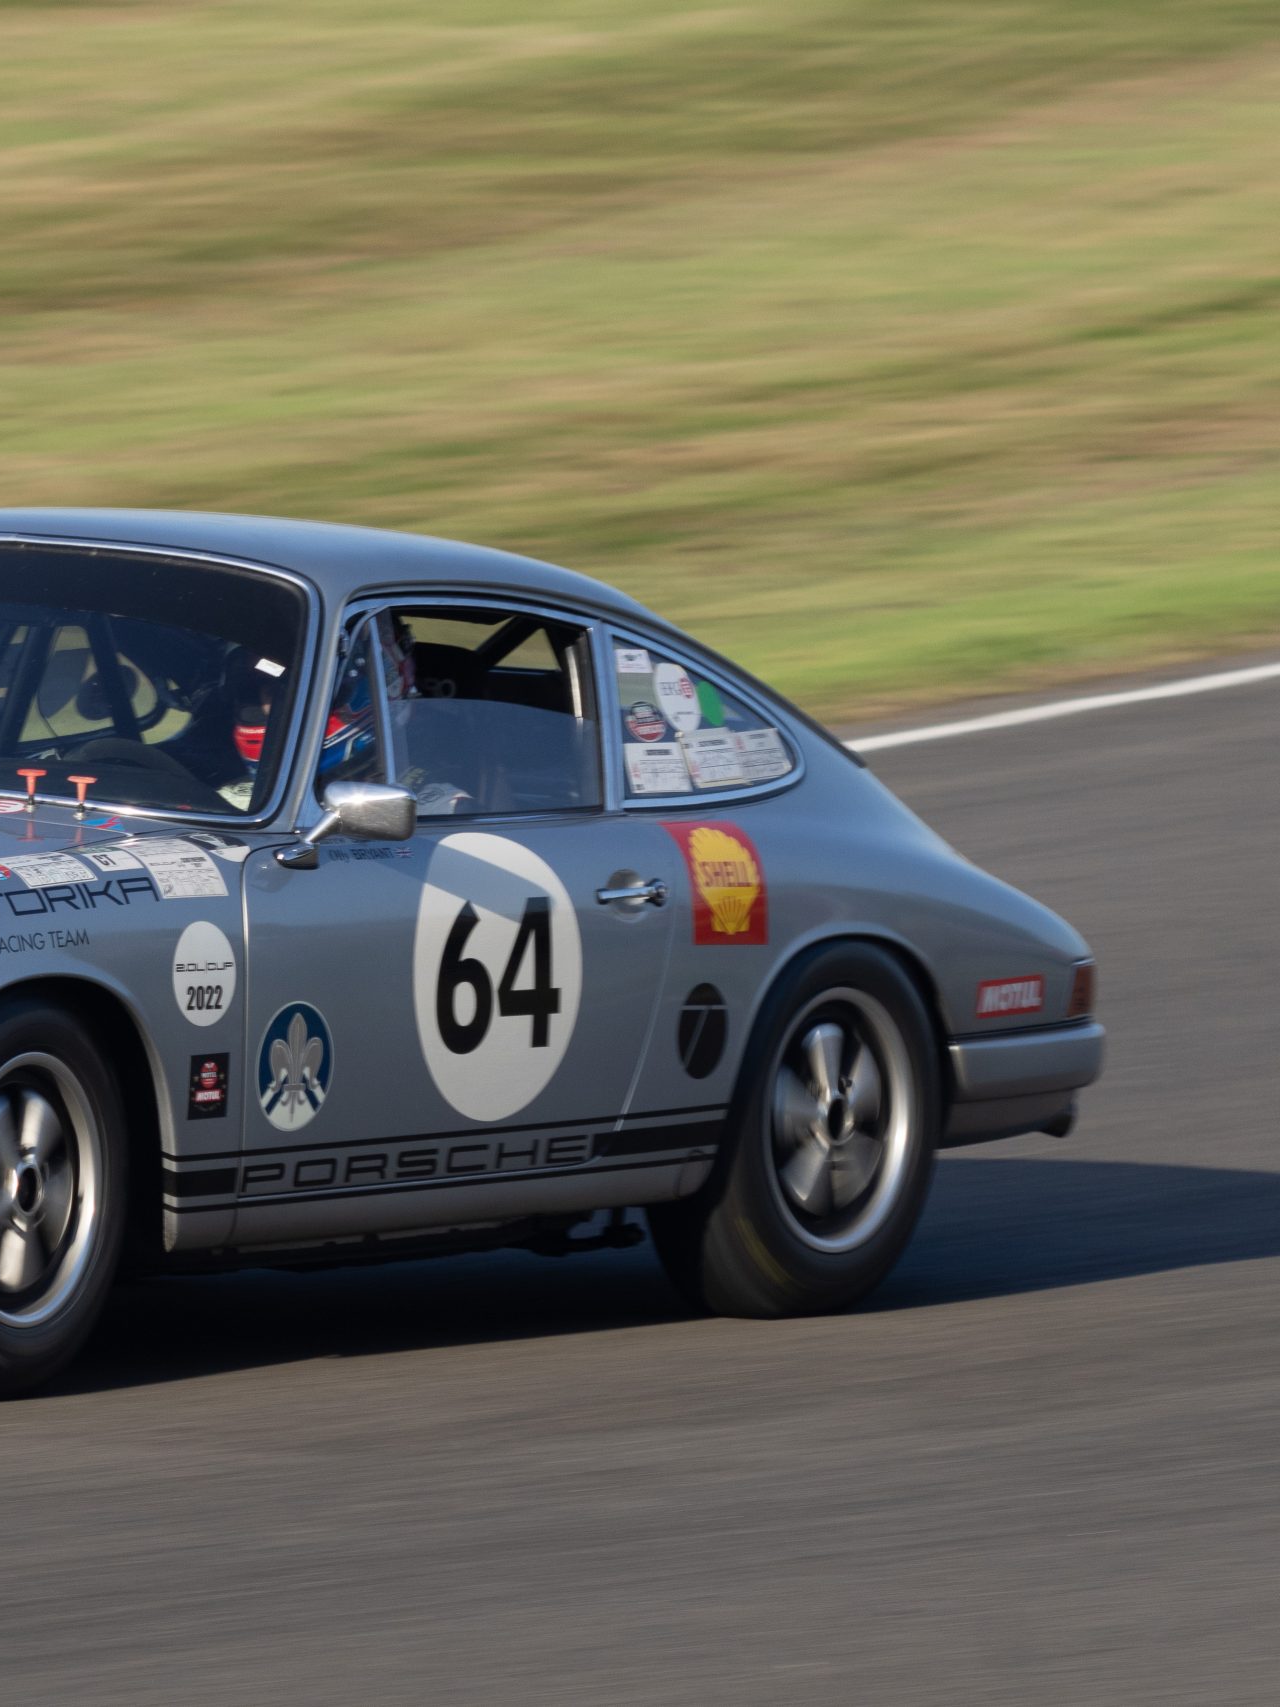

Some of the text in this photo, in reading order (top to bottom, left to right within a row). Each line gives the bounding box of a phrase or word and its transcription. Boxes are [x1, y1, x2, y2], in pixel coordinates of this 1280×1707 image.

[699, 861, 752, 887] SHELL
[49, 928, 90, 948] TEAM
[436, 896, 561, 1055] 64
[186, 985, 223, 1011] 2022
[980, 980, 1042, 1013] MOTUL
[240, 1134, 591, 1193] PORSCHE
